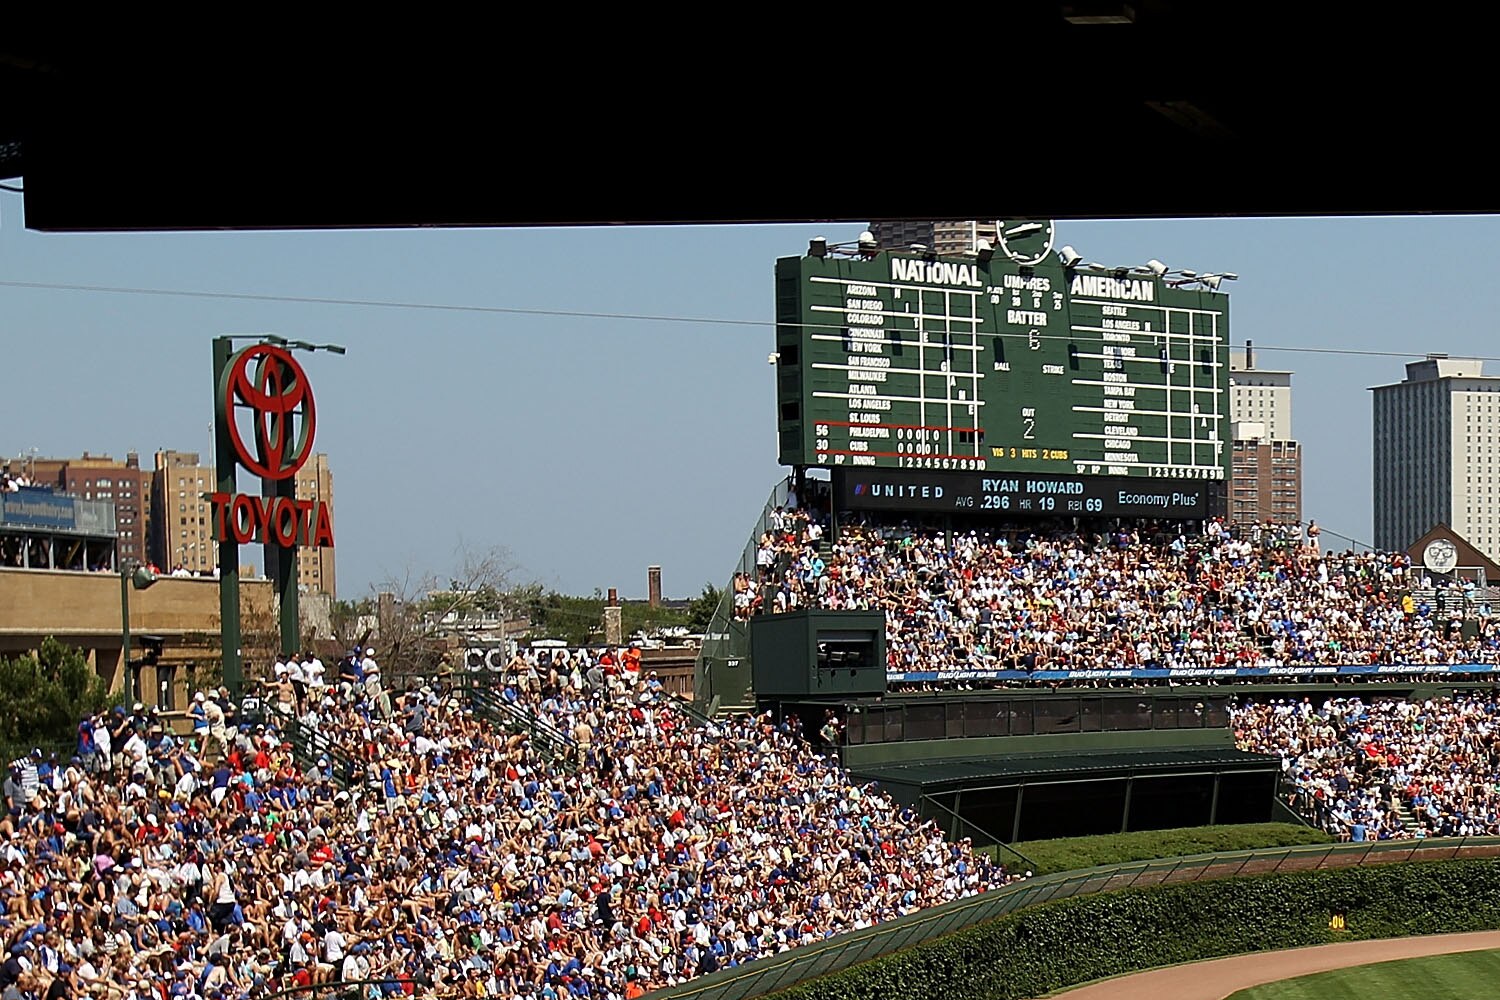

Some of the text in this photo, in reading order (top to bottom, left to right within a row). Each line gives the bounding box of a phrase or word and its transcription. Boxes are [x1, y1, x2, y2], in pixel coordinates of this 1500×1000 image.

[892, 258, 982, 286] NATIONAL
[1004, 274, 1050, 291] UMPIRES
[1071, 275, 1153, 301] AMERICAN
[847, 285, 877, 296] ARIZONA
[847, 299, 883, 311] SAN DIEGO
[1102, 306, 1127, 316] SEATTLE
[847, 314, 883, 325] COLORADO
[1008, 310, 1047, 326] BATTER
[1102, 319, 1140, 331] LOS ANGELES
[848, 328, 884, 339] CINCINNATI
[1029, 329, 1040, 349] 6
[1102, 333, 1130, 343] TORONTO
[864, 343, 882, 353] YORK
[848, 356, 890, 368] SAN FRANCISCO
[994, 362, 1010, 371] BALL
[1104, 359, 1122, 369] TEXAS
[1042, 365, 1064, 374] STRIKE
[848, 370, 887, 382] MILWAUKEE
[1104, 372, 1127, 382] BOSTON
[849, 384, 877, 395] ATLANTA
[1104, 386, 1135, 396] TAMPA BAY
[849, 399, 891, 410] LOS ANGELES
[1104, 399, 1134, 409] NEW YORK
[1022, 408, 1035, 417] OUT
[1104, 412, 1128, 422] DETROIT
[860, 414, 880, 423] LOUIS
[816, 425, 828, 436] 56
[850, 427, 889, 438] PHILADELPHIA
[898, 428, 903, 439] 0
[907, 429, 913, 439] 0
[916, 429, 922, 440] 0
[934, 430, 940, 441] 0
[1024, 419, 1035, 439] 2
[1105, 426, 1138, 436] CLEVELAND
[816, 439, 828, 450] 30
[850, 441, 868, 452] CUBS
[898, 443, 904, 454] 0
[907, 443, 913, 454] 0
[916, 443, 922, 454] 0
[925, 444, 931, 454] 0
[1105, 439, 1130, 449] CHICAGO
[992, 448, 1068, 459] VIS 3 HITS 2 CUBS
[1104, 453, 1138, 463] MINNESOTA
[817, 454, 827, 464] SP
[835, 454, 845, 464] RP
[853, 455, 875, 466] INNING
[907, 457, 913, 467] 2
[916, 457, 922, 467] 3
[925, 458, 931, 468] 4
[934, 458, 940, 468] 5
[943, 458, 949, 468] 6
[952, 459, 957, 469] 7
[960, 459, 966, 469] 8
[969, 459, 975, 469] 9
[977, 460, 986, 470] 10
[1156, 468, 1161, 477] 2
[1163, 468, 1169, 477] 3
[1171, 469, 1176, 477] 4
[1179, 469, 1184, 478] 5
[1187, 469, 1192, 478] 6
[1194, 470, 1199, 478] 7
[1202, 470, 1207, 479] 8
[1210, 470, 1215, 479] 9
[1216, 471, 1224, 480] 10
[872, 485, 943, 498] UNITED
[982, 479, 1084, 494] RYAN HOWARD
[956, 495, 1102, 512] AVG .296 HR 19 RBI 69
[1119, 491, 1169, 508] Economy
[212, 492, 334, 547] TOYOTA
[1187, 668, 1213, 676] LIGHT
[1398, 664, 1425, 672] LIGHT
[953, 671, 976, 679] LIGHT
